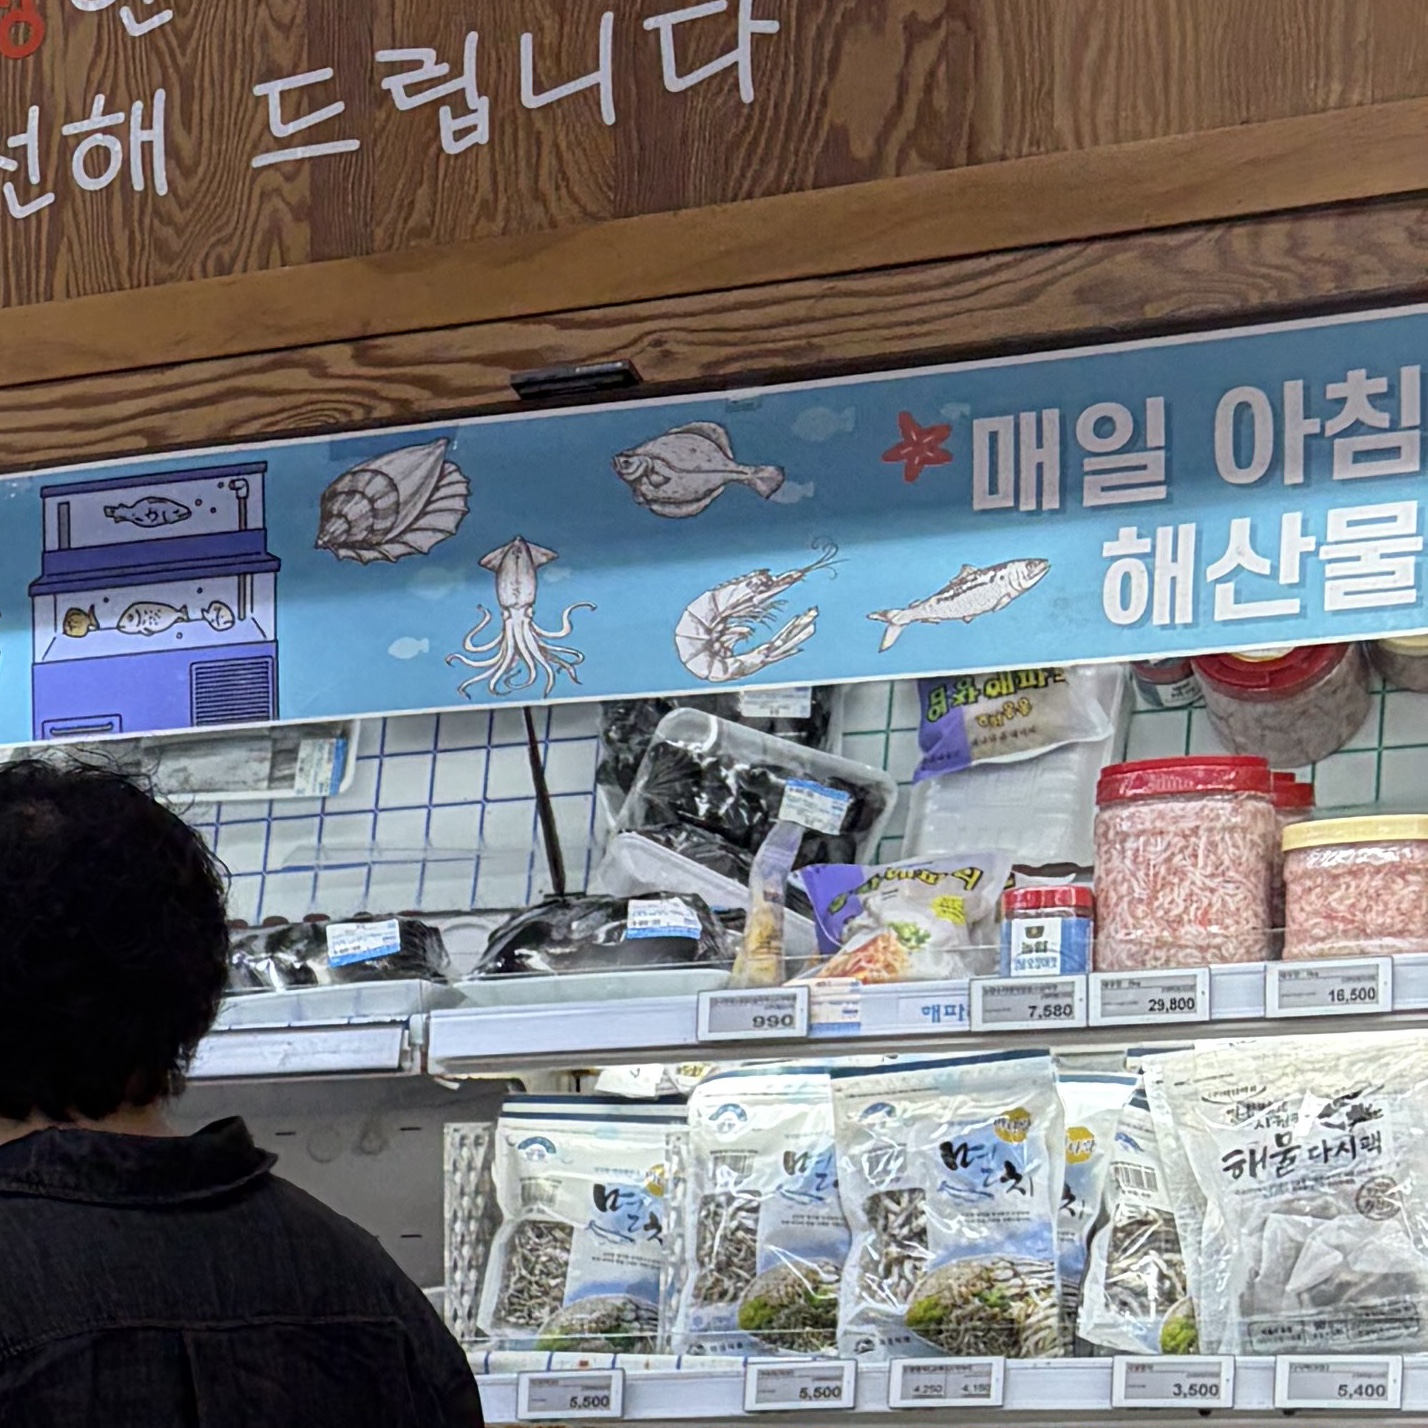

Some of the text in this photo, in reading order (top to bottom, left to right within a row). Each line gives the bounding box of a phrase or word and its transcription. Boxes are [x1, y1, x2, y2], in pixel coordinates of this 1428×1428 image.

[251, 0, 781, 168] 드립니다
[971, 364, 1422, 514] 매일 아침
[1102, 500, 1424, 628] 해산물
[920, 1002, 972, 1025] 해파
[1027, 1003, 1074, 1020] 7,580
[1147, 996, 1196, 1014] 29,800
[798, 1386, 843, 1401] 5,500
[1171, 1381, 1220, 1399] 3,500
[1336, 1382, 1387, 1400] 5,400
